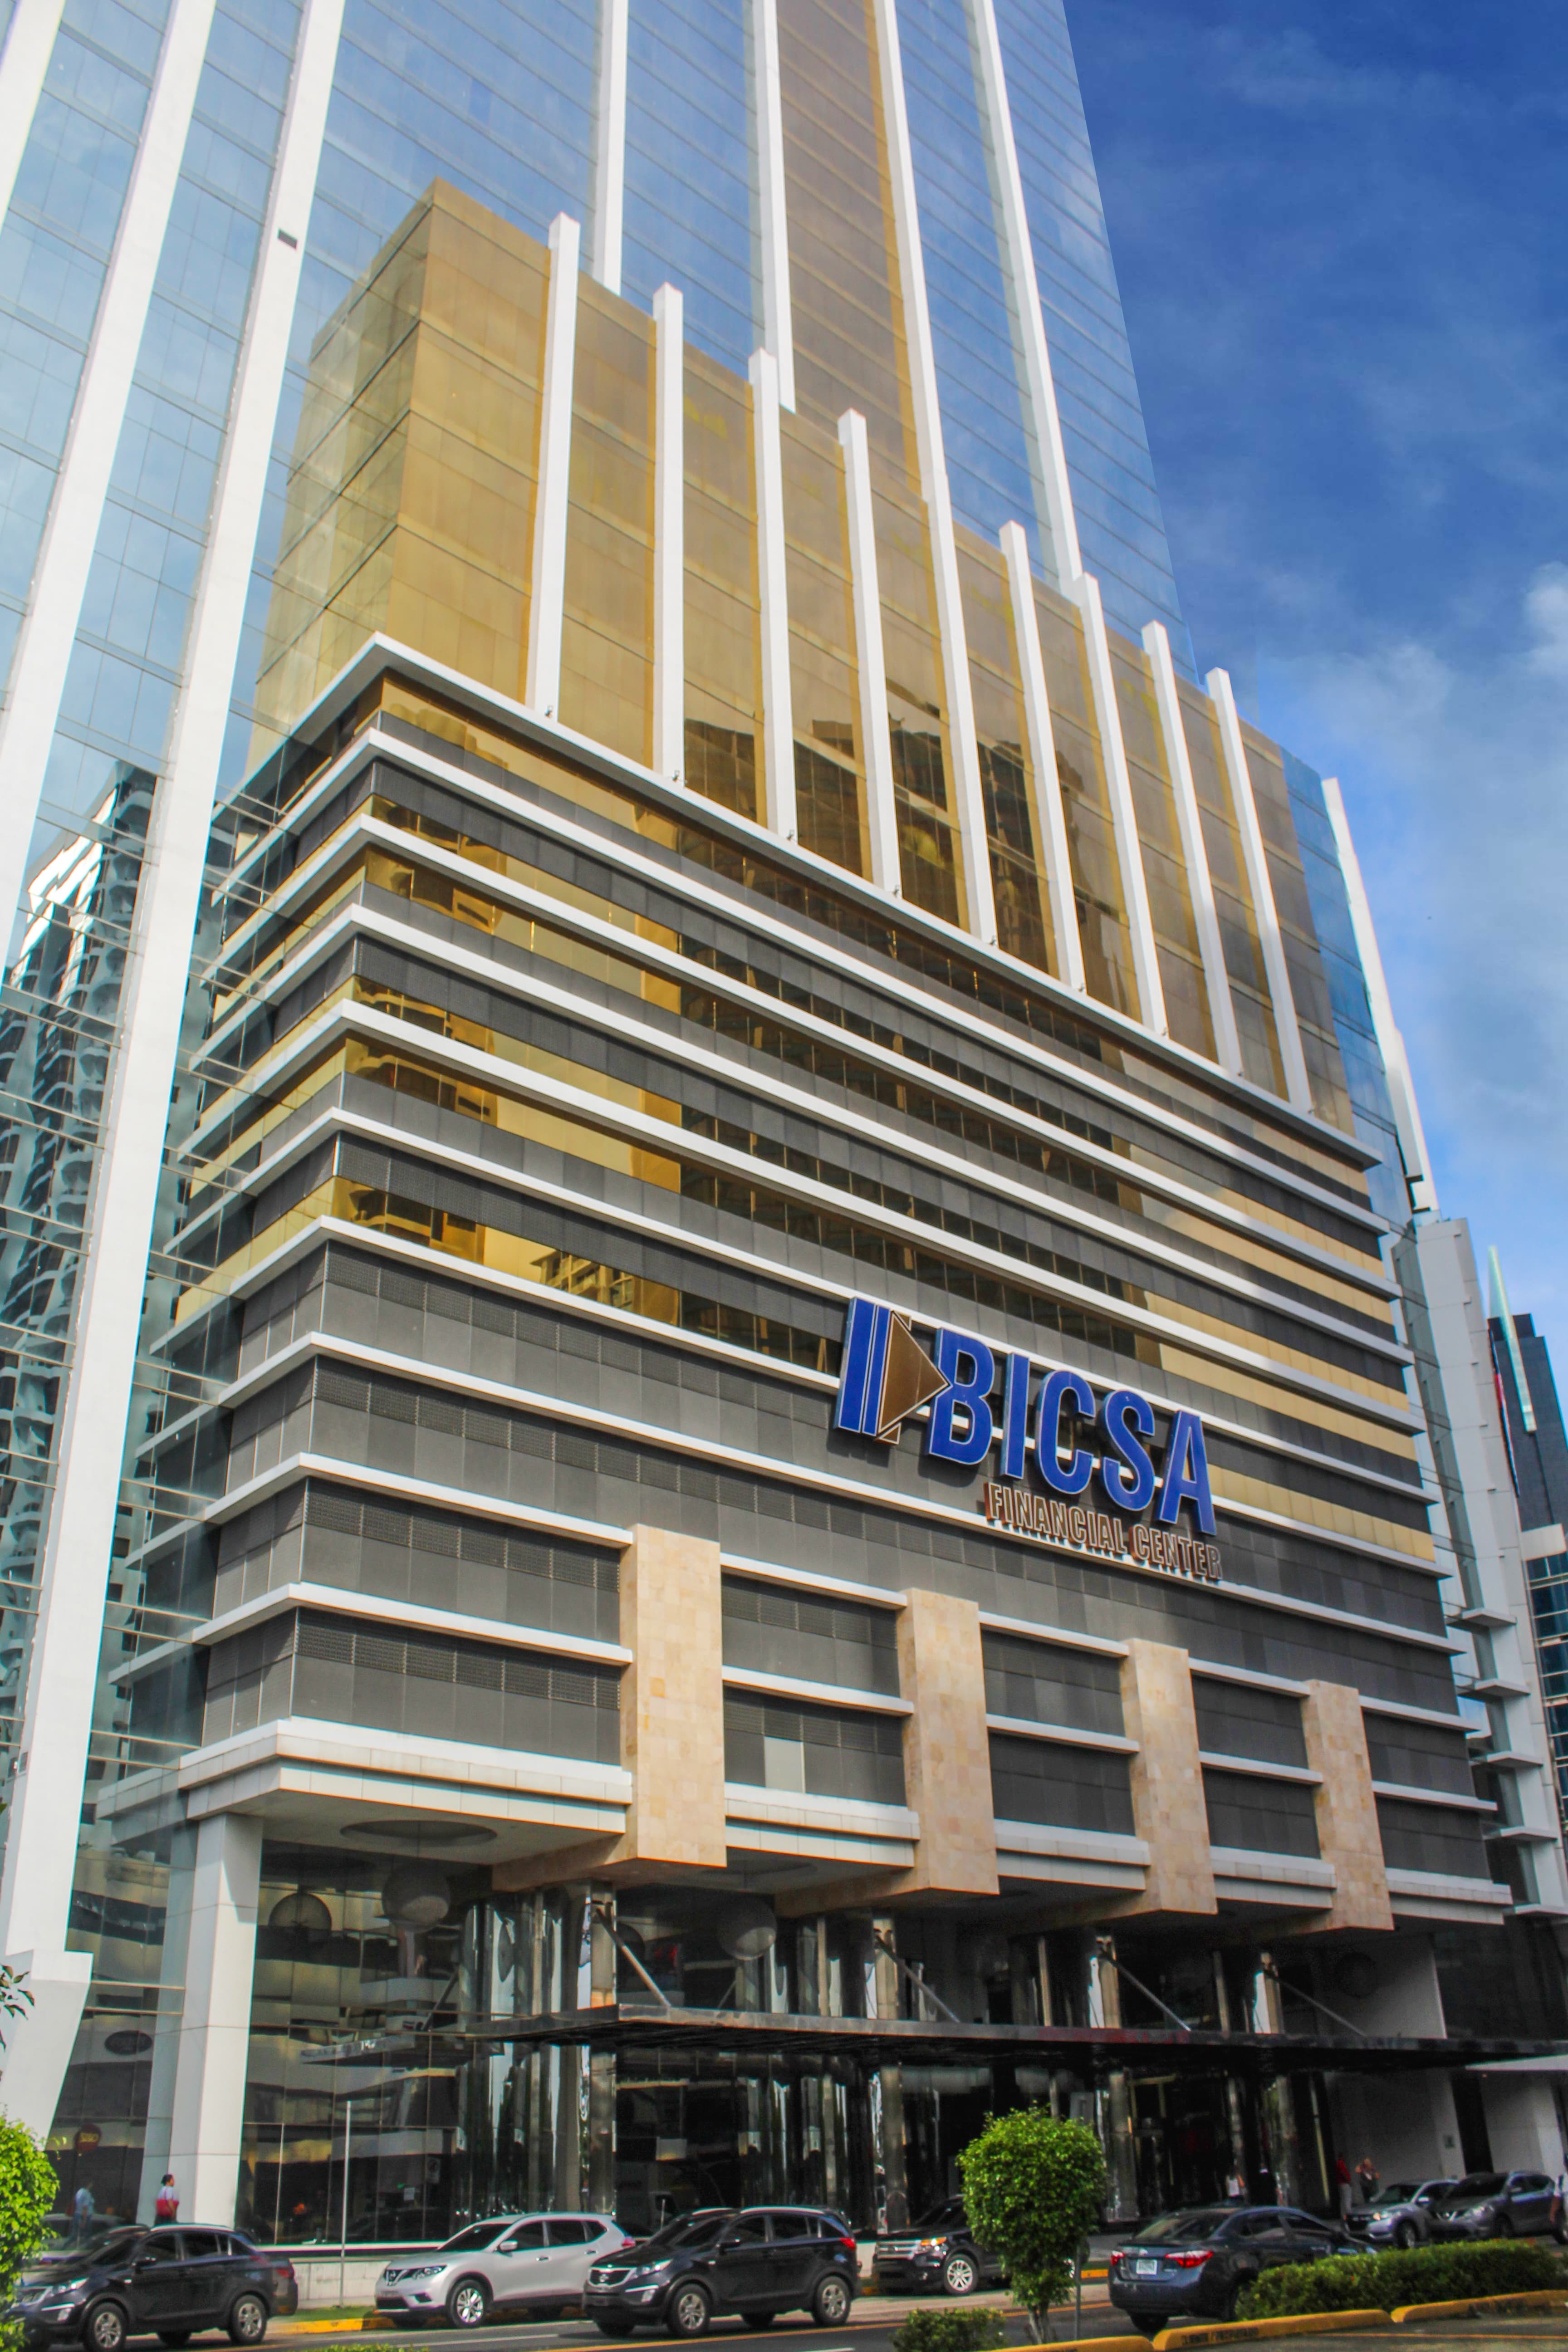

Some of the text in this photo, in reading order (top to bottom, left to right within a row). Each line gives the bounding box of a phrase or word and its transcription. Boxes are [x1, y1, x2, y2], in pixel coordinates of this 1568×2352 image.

[926, 1327, 1216, 1536] BICSA
[985, 1481, 1223, 1580] FINANCIAL CENTER
